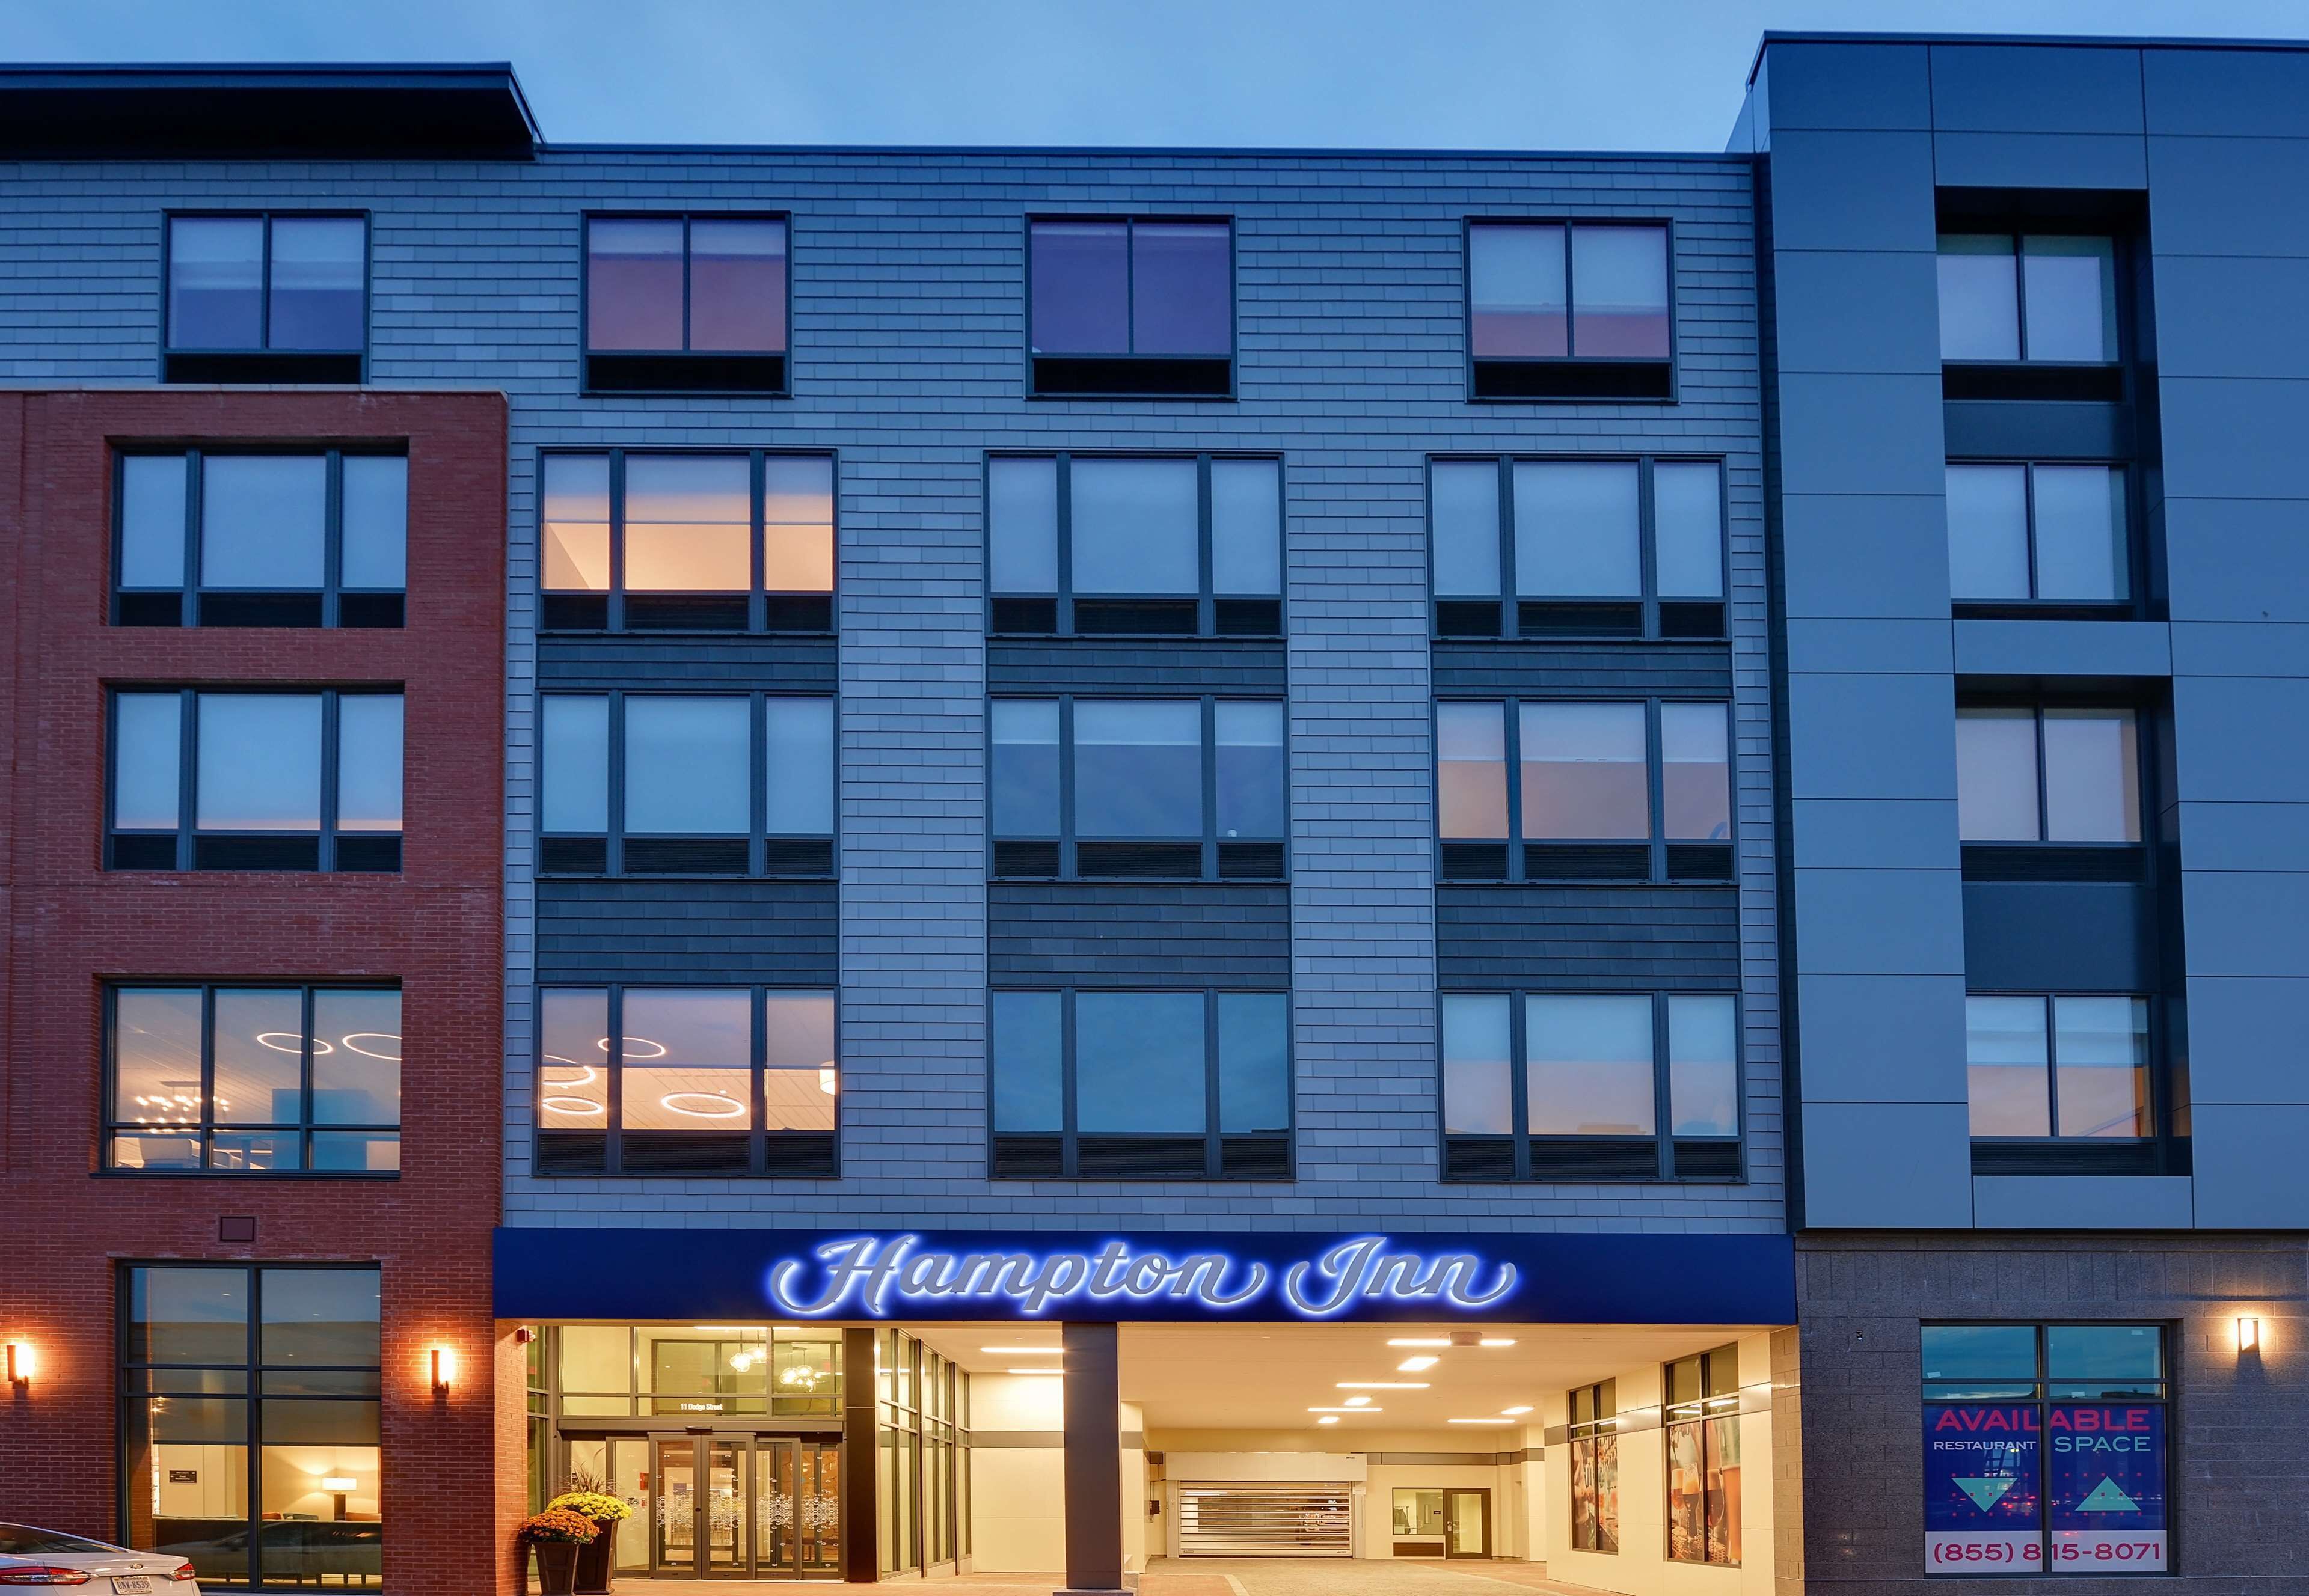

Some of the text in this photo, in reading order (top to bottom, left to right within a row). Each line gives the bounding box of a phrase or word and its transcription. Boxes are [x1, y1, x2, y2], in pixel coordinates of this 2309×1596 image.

[771, 1234, 1517, 1313] Hampton Inn
[688, 1403, 705, 1411] Dodge
[1934, 1409, 2151, 1431] AVAILABLE
[1933, 1435, 2151, 1452] RESTAURANT SPACE
[1934, 1542, 2160, 1563] (855) 815-8071
